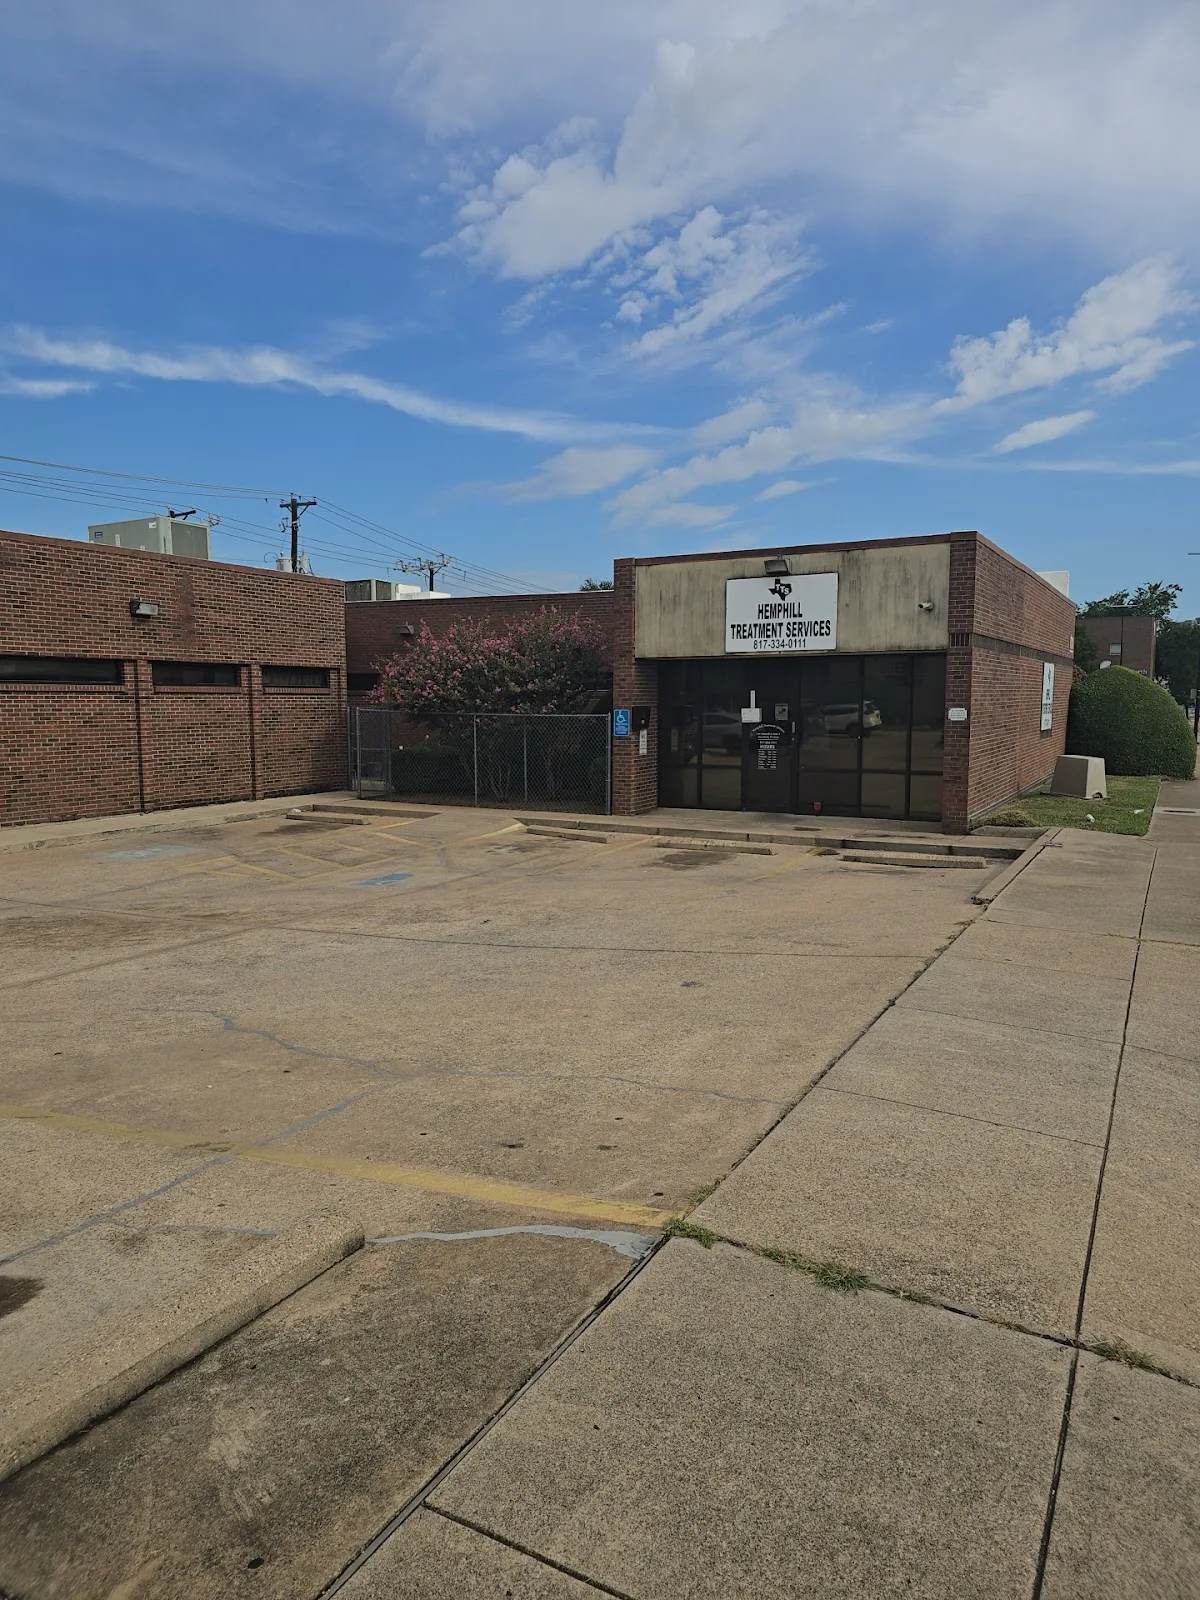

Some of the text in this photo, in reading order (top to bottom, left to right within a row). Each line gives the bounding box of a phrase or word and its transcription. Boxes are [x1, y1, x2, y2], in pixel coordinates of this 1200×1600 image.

[775, 584, 789, 594] TTS
[757, 602, 803, 619] HEMPHILL
[730, 619, 831, 639] TREATMENT SERVICES
[753, 639, 806, 649] 817-334-0111
